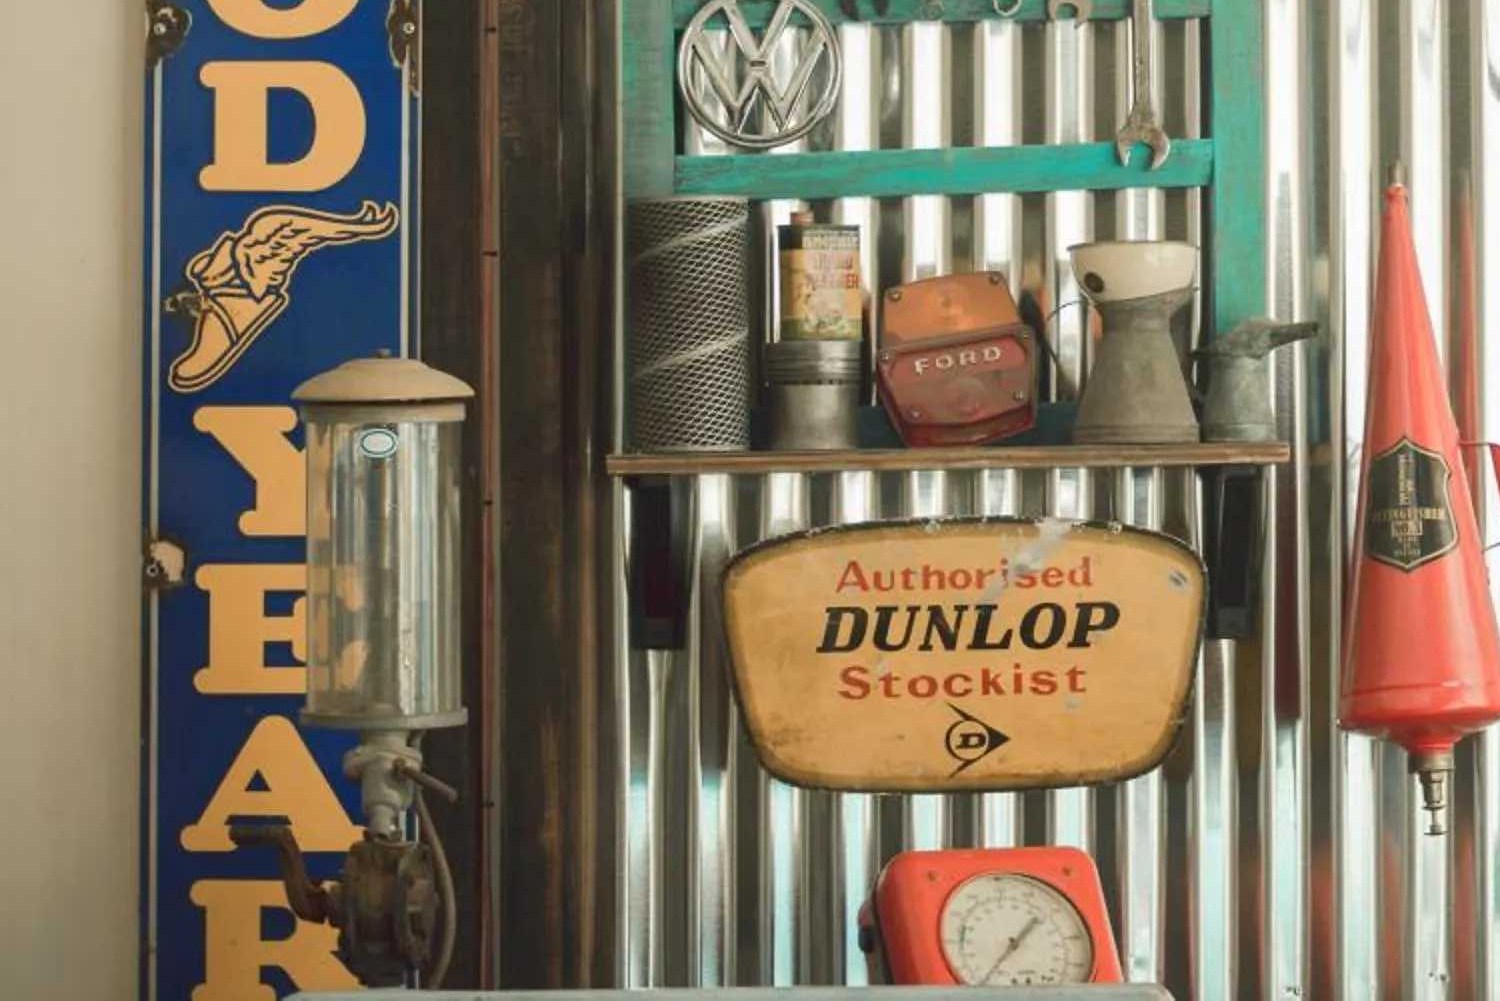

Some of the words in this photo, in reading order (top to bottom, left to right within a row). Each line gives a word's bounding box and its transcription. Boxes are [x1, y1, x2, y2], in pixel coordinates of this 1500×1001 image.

[914, 346, 1002, 376] FORD
[836, 557, 1092, 594] Authorised
[815, 601, 1120, 654] DUNLOP
[837, 663, 1087, 701] Stockist
